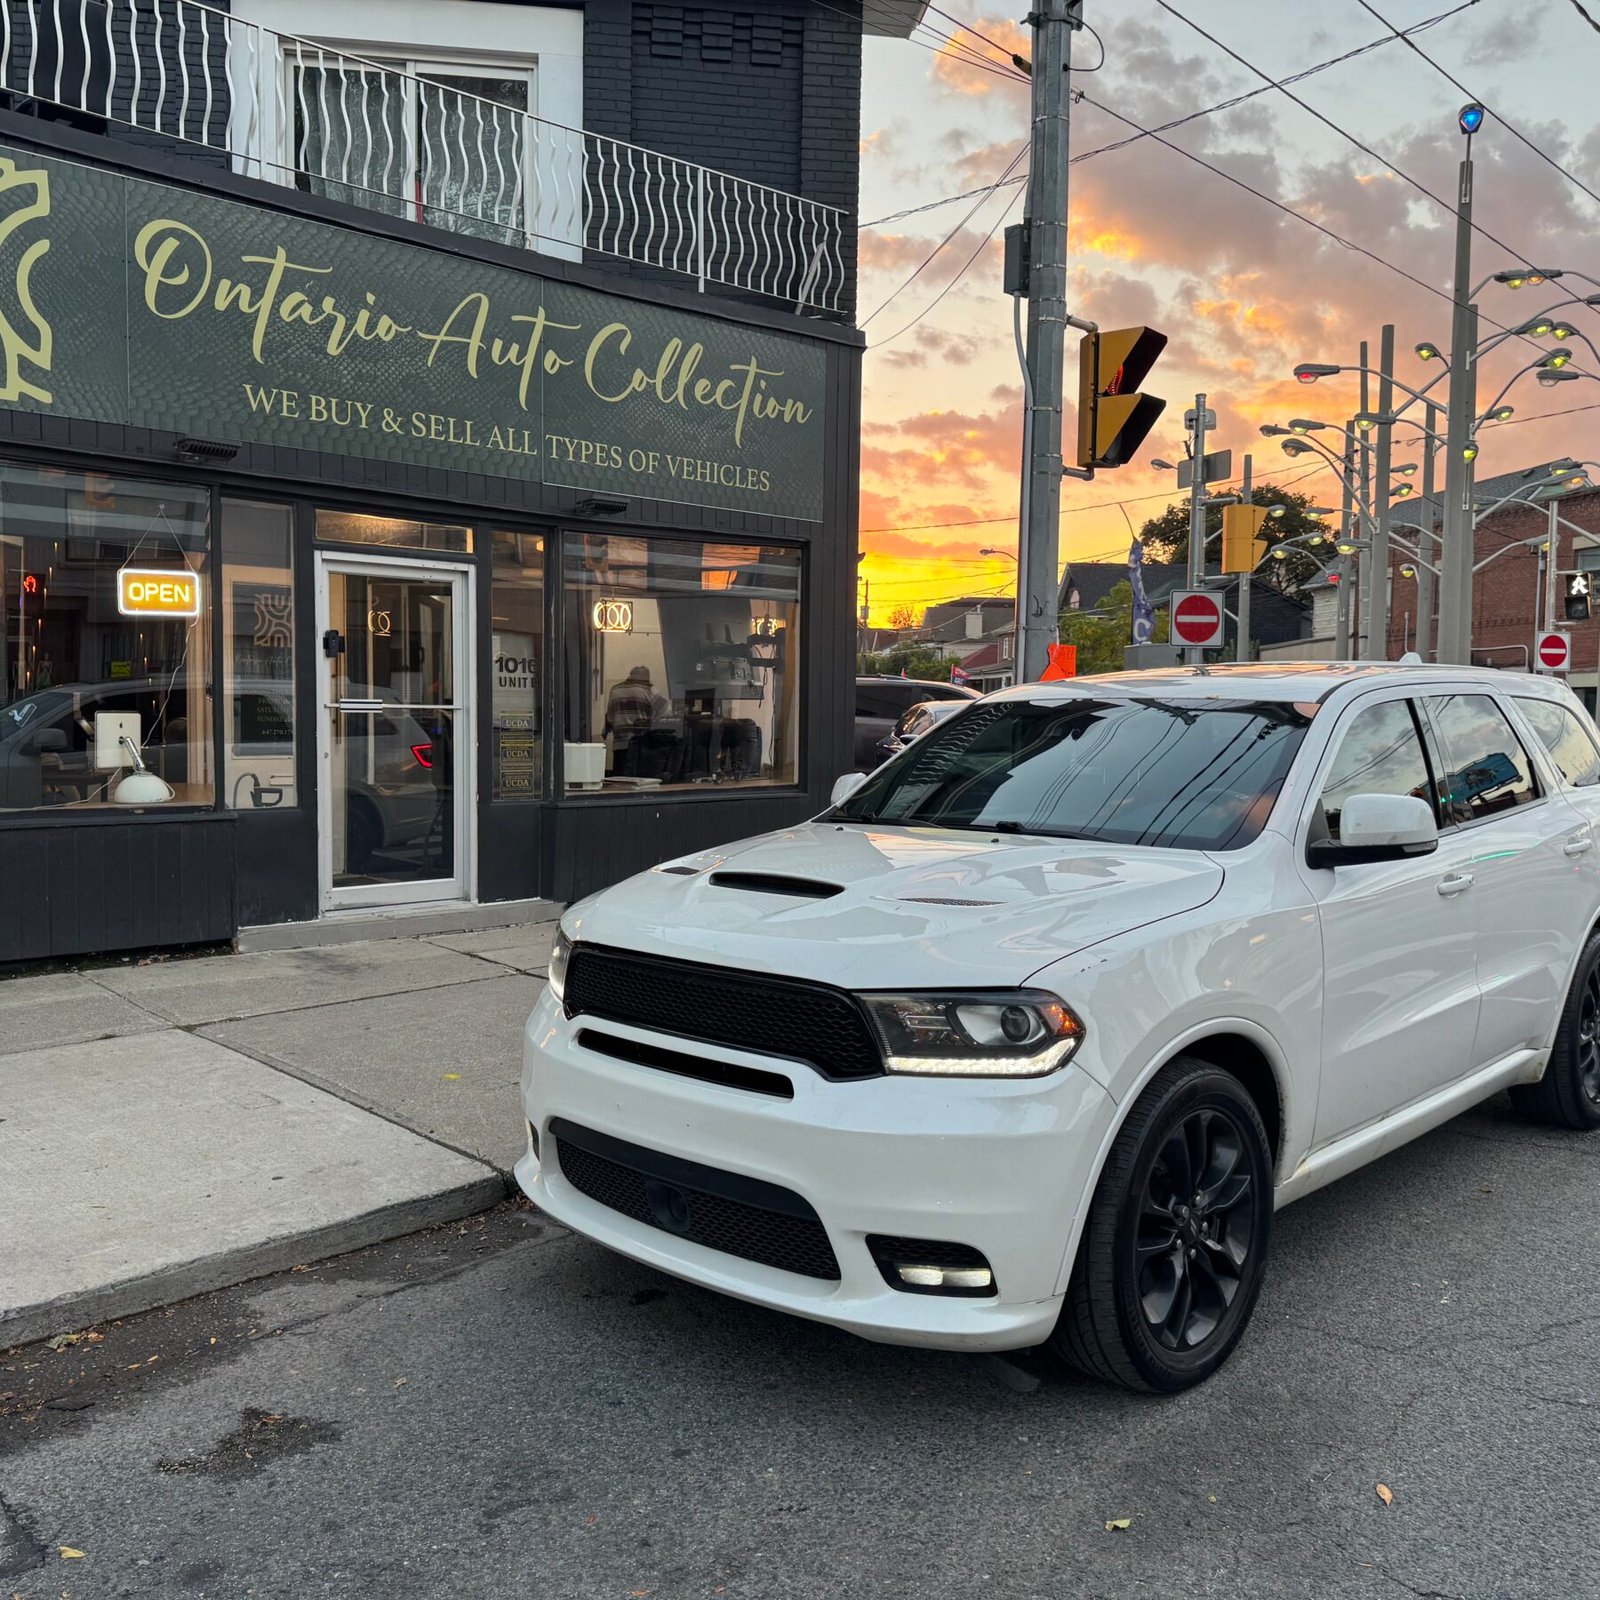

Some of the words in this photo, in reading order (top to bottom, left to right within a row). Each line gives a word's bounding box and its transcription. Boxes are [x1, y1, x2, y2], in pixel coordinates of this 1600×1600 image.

[134, 218, 412, 364] Ontario
[416, 292, 581, 411] Auto
[584, 322, 812, 449] Collection
[243, 384, 299, 418] WE
[309, 394, 374, 429] BUY
[381, 407, 404, 435] &
[411, 412, 480, 446] SELL
[487, 425, 537, 455] ALL
[545, 434, 622, 469] TYPES
[628, 449, 660, 474] OF
[665, 454, 770, 492] VEHICLES
[128, 582, 190, 603] OPEN
[499, 676, 528, 689] UNIT
[505, 750, 529, 758] UCDA
[505, 779, 530, 787] UCDA
